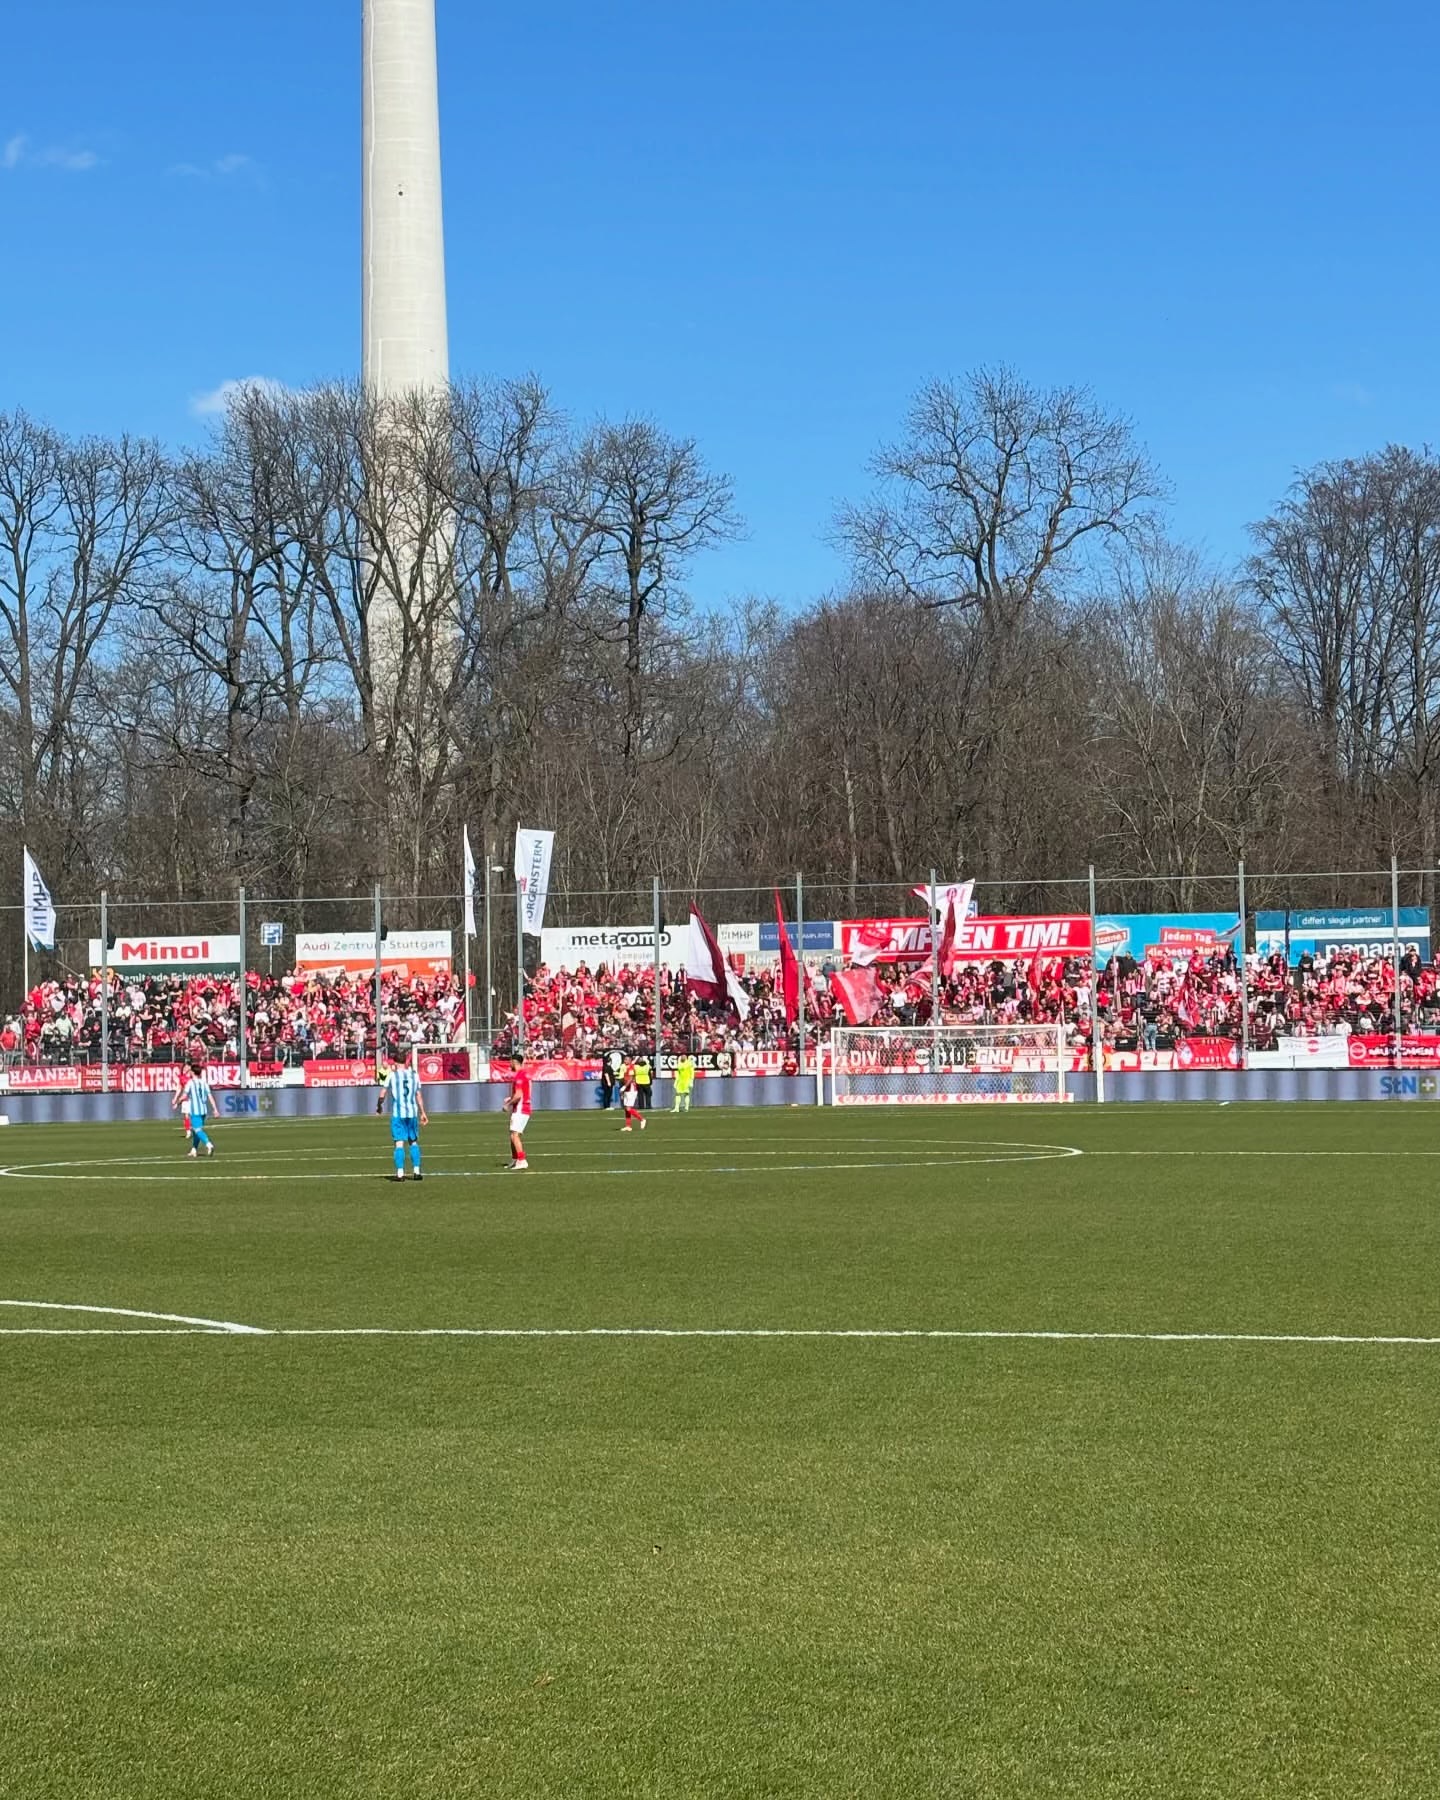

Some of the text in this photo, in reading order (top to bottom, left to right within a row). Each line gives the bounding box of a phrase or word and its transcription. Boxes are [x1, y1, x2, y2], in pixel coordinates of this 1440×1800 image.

[526, 839, 543, 923] ORGENSTERN
[1004, 922, 1070, 948] TIM!
[1194, 933, 1212, 944] Tag
[121, 941, 209, 960] Minol
[302, 943, 331, 951] Audi
[389, 939, 446, 950] Stuttgart
[126, 1067, 180, 1092] SELTERS
[402, 1080, 410, 1097] 5
[1380, 1076, 1417, 1094] StN
[225, 1095, 257, 1112] StN
